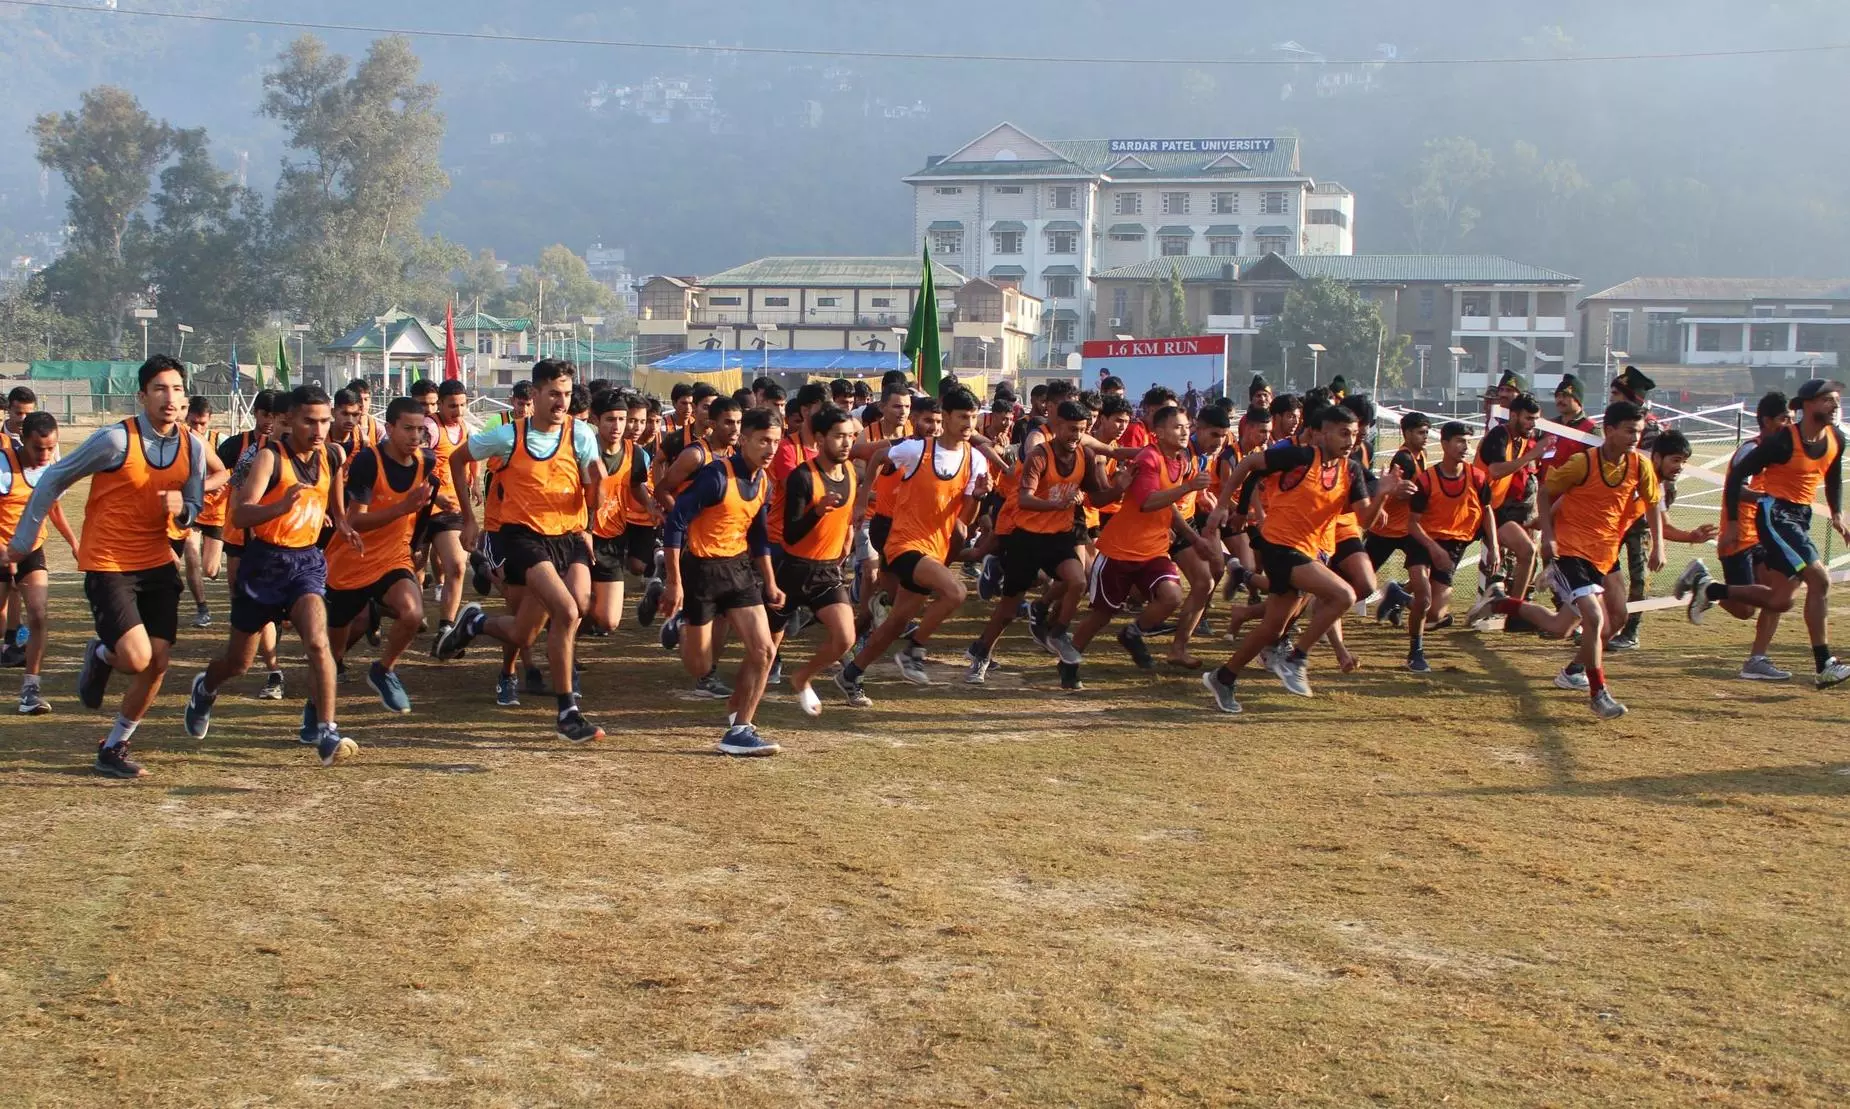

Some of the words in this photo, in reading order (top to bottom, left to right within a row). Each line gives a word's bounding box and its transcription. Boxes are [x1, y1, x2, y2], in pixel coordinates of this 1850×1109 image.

[1111, 140, 1158, 151] SARDAR
[1161, 140, 1197, 151] PATEL
[1201, 139, 1271, 150] UNIVERSITY
[1107, 344, 1128, 356] 1.6
[1132, 342, 1159, 355] KM
[1164, 340, 1199, 354] RUN
